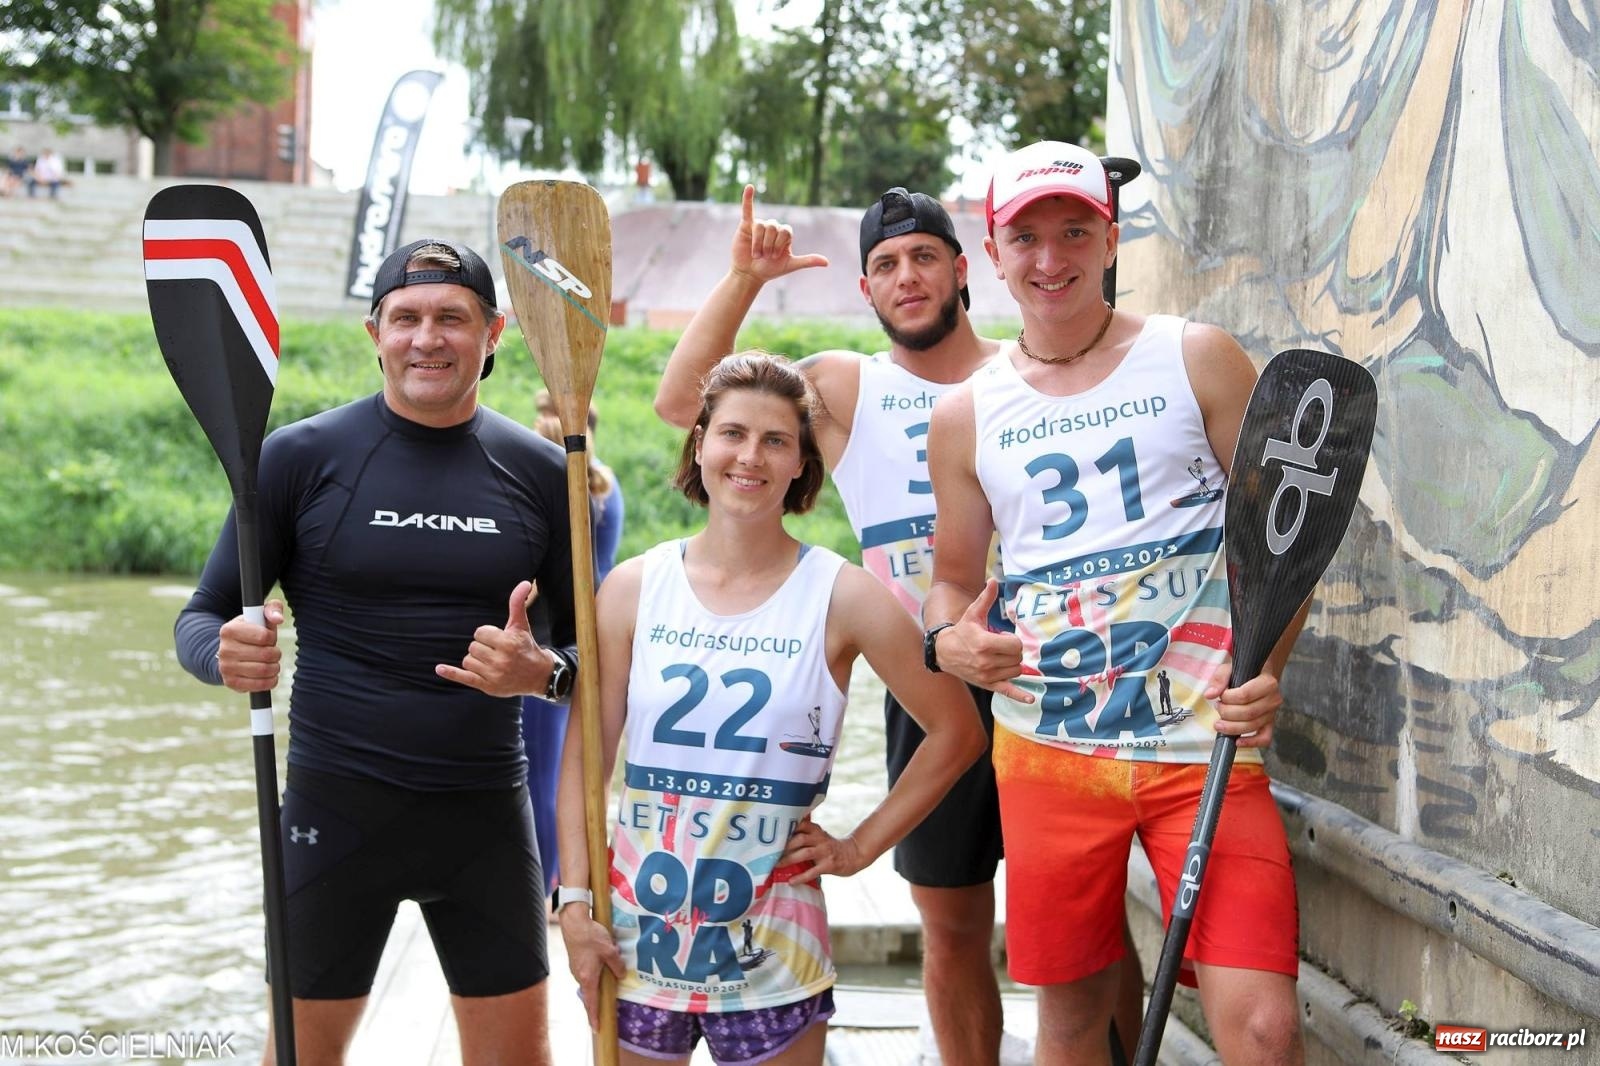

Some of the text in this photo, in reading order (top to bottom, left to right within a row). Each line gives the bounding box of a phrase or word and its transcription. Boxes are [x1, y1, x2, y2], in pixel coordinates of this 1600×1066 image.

[504, 236, 592, 299] NSP
[881, 391, 938, 411] #odr
[999, 396, 1166, 449] #odrasupcup
[1024, 437, 1145, 541] 31
[369, 510, 501, 533] DAKINE
[909, 519, 936, 537] 1-3
[1046, 544, 1178, 584] 1-3.09.2023
[1016, 582, 1118, 619] LETS
[650, 624, 802, 658] #odrasupcup
[653, 663, 772, 753] 22
[647, 773, 773, 799] 1-3.09.2023
